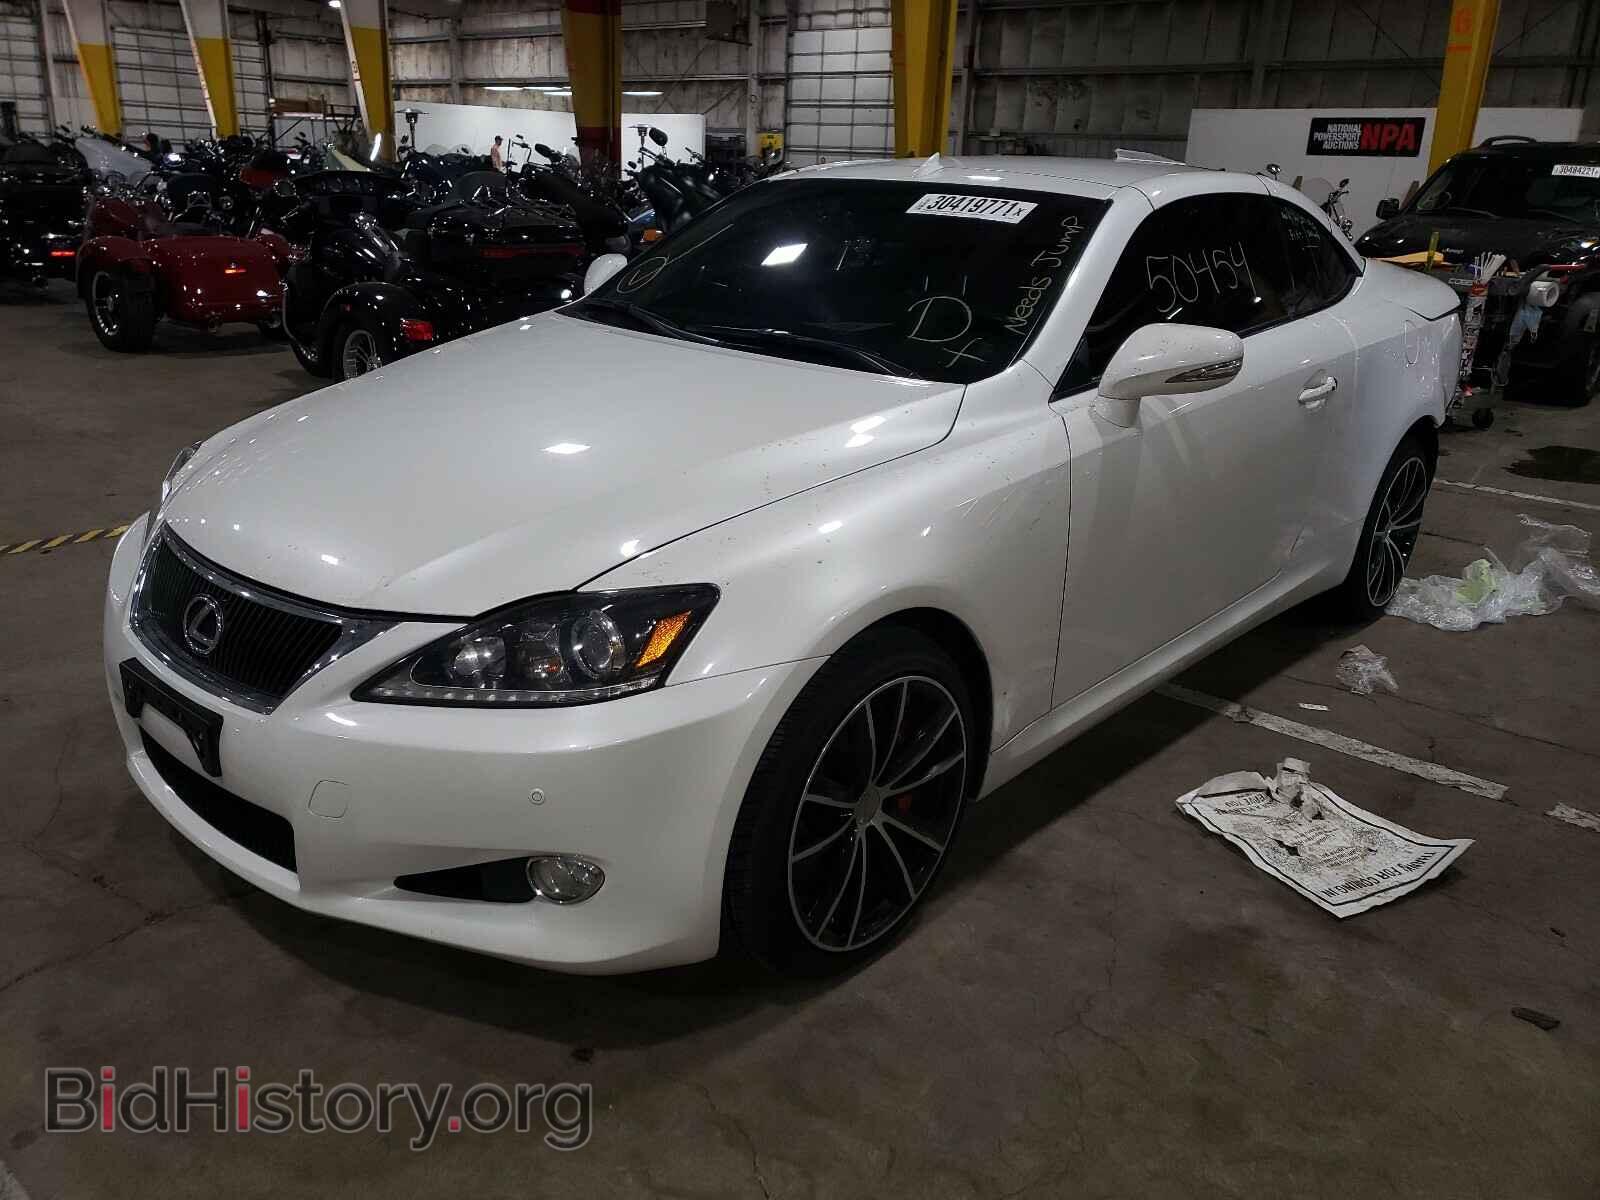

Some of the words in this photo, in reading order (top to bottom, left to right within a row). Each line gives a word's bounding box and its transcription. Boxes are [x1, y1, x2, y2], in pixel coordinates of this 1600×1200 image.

[1327, 123, 1362, 133] NATIONAL
[1313, 132, 1361, 142] POWERSPORT
[1361, 122, 1417, 151] NPA
[1322, 141, 1360, 150] AUCTIONS
[926, 195, 1019, 217] 30419771
[1003, 276, 1053, 336] Needs
[1031, 215, 1085, 268] Jump
[1146, 241, 1258, 313] 50454
[1373, 866, 1401, 881] FOR
[1320, 887, 1340, 898] IN
[1334, 876, 1380, 894] COMING
